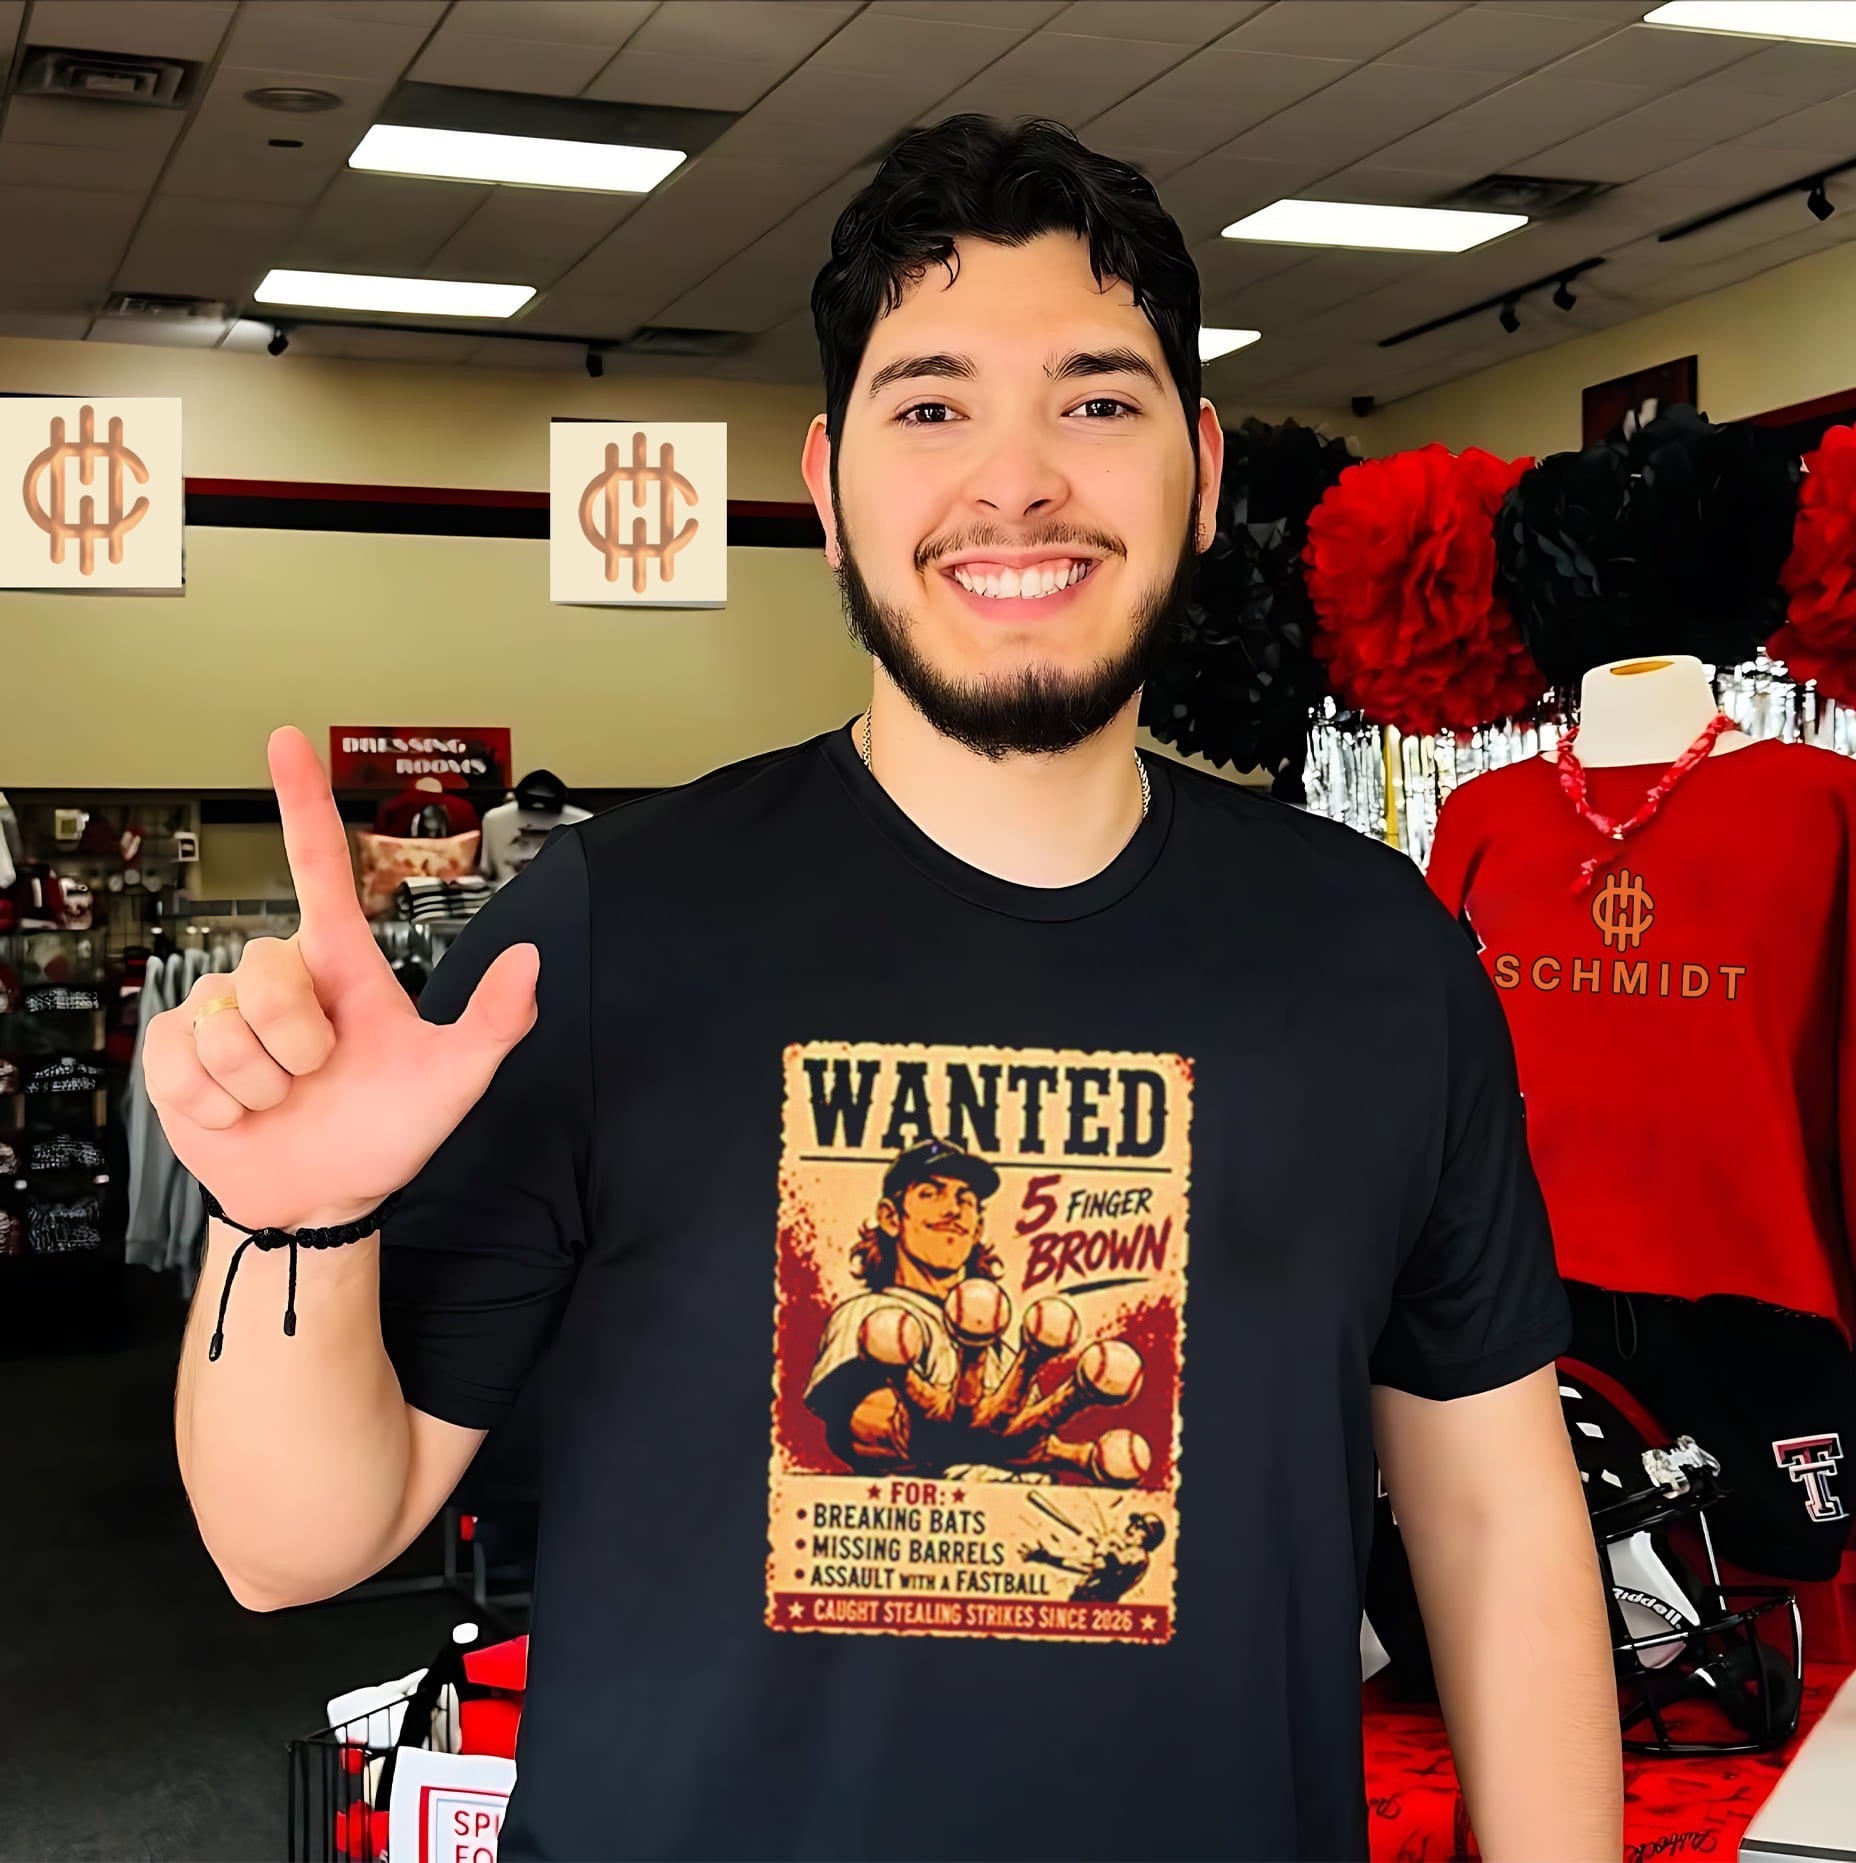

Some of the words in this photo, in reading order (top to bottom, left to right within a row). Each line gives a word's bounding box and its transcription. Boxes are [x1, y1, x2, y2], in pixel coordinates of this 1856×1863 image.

[342, 737, 466, 753] DRESSING
[396, 759, 487, 774] ROOMS
[1494, 954, 1746, 1000] SCHMIDT
[803, 1057, 1170, 1158] WANTED
[1015, 1174, 1061, 1235] 5
[1066, 1187, 1152, 1222] FINGER
[1021, 1216, 1172, 1293] BROWN
[890, 1482, 945, 1506] FOR:
[813, 1503, 921, 1532] BREAKING
[930, 1509, 985, 1535] BATS
[812, 1535, 900, 1562] MISSING
[909, 1539, 1004, 1566] BARRELS
[810, 1565, 895, 1589] ASSAULT
[900, 1574, 936, 1590] WITH
[940, 1575, 950, 1590] A
[956, 1570, 1050, 1596] FASTBALL
[813, 1599, 877, 1622] CAUGHT
[883, 1602, 961, 1625] STEALING
[966, 1605, 1035, 1628] STRIKES
[1039, 1607, 1087, 1630] SINCE
[1092, 1610, 1133, 1632] 2026
